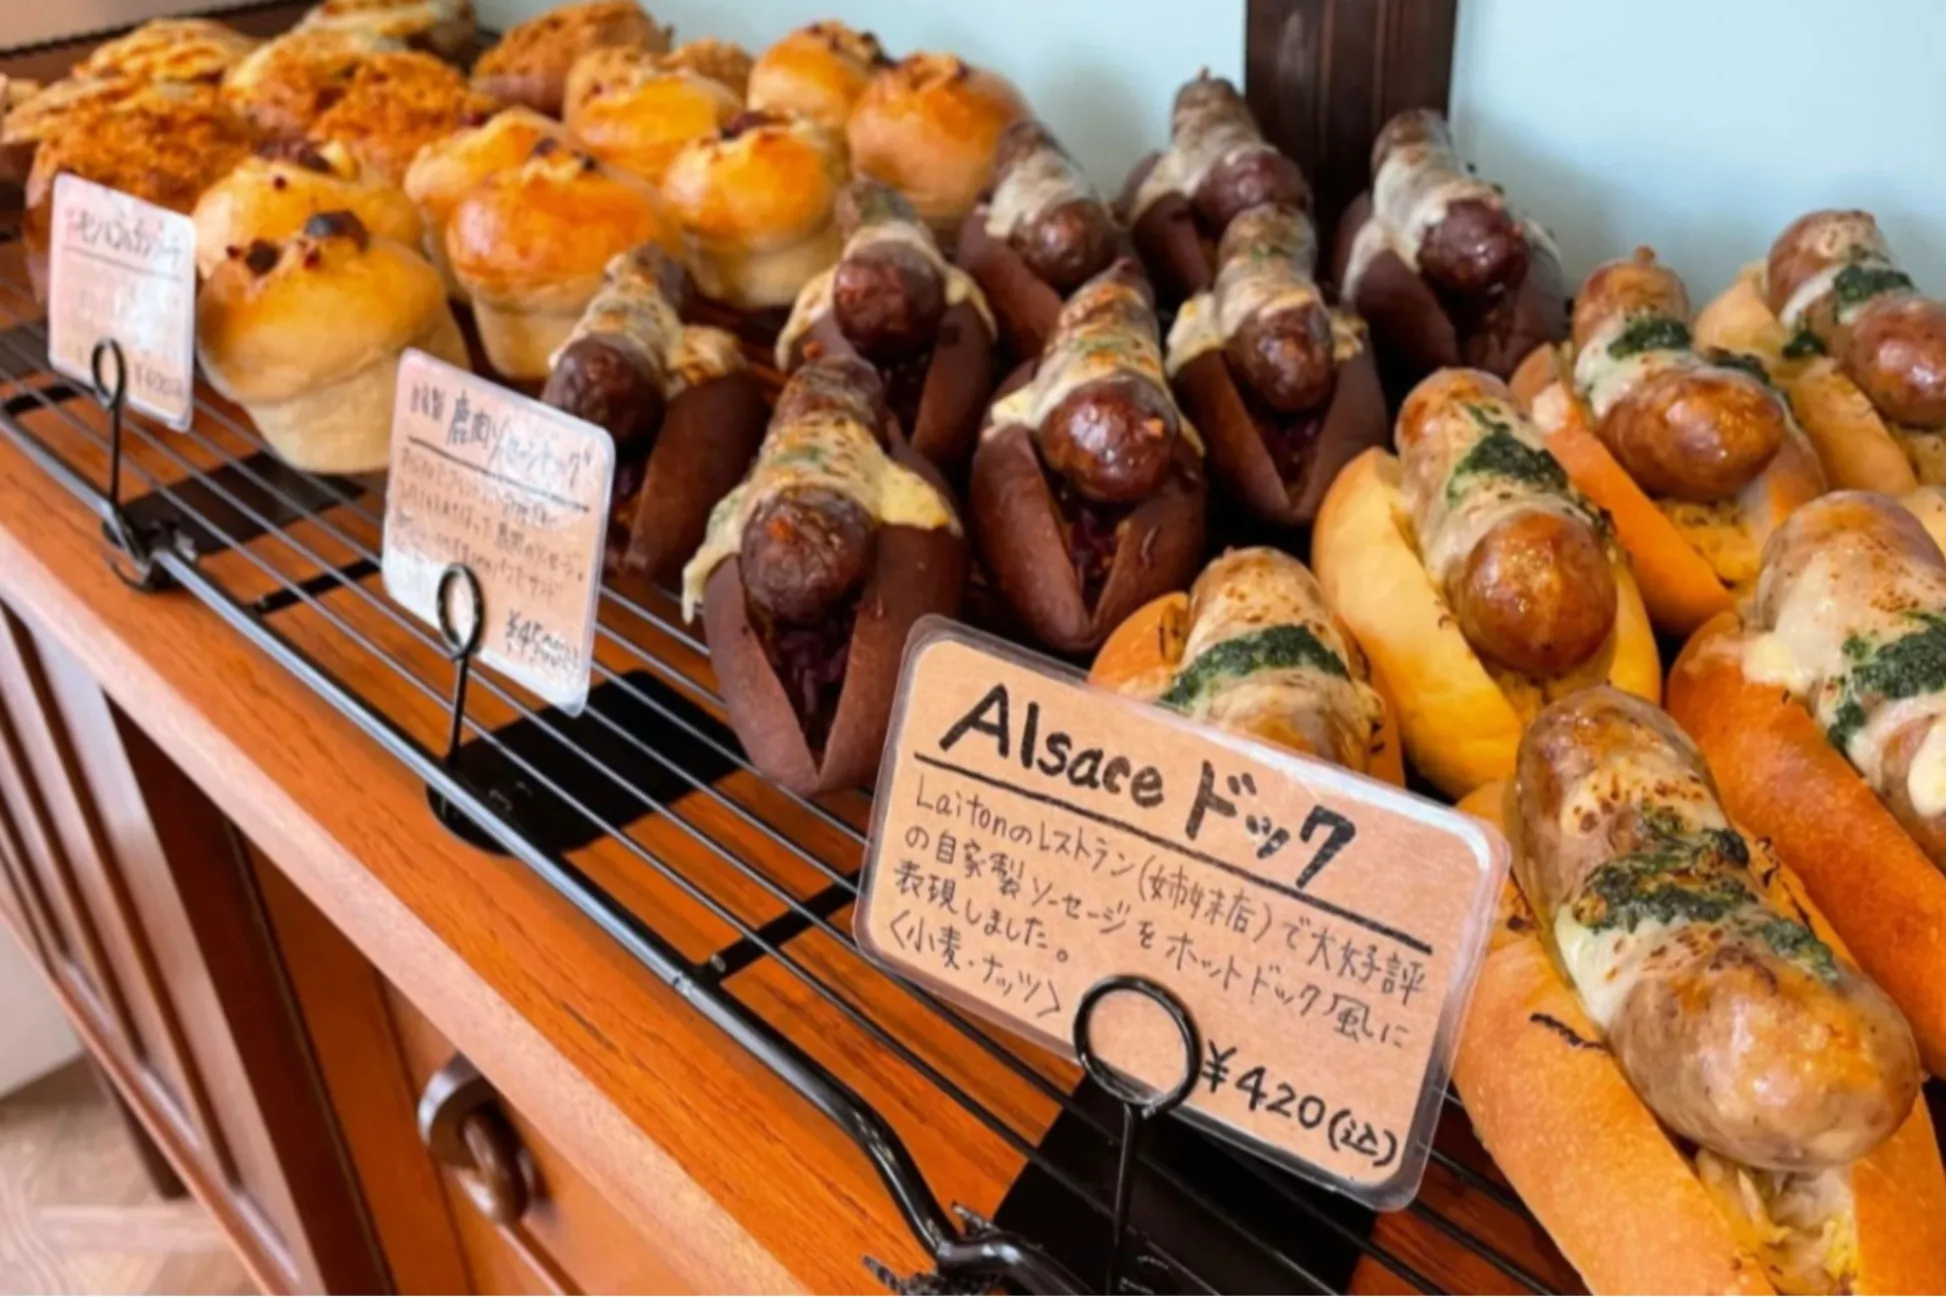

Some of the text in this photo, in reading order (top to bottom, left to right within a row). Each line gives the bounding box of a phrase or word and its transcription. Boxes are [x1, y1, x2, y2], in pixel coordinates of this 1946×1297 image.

[939, 683, 1357, 889] Alsace ドック
[894, 858, 1069, 963] 表現しました。
